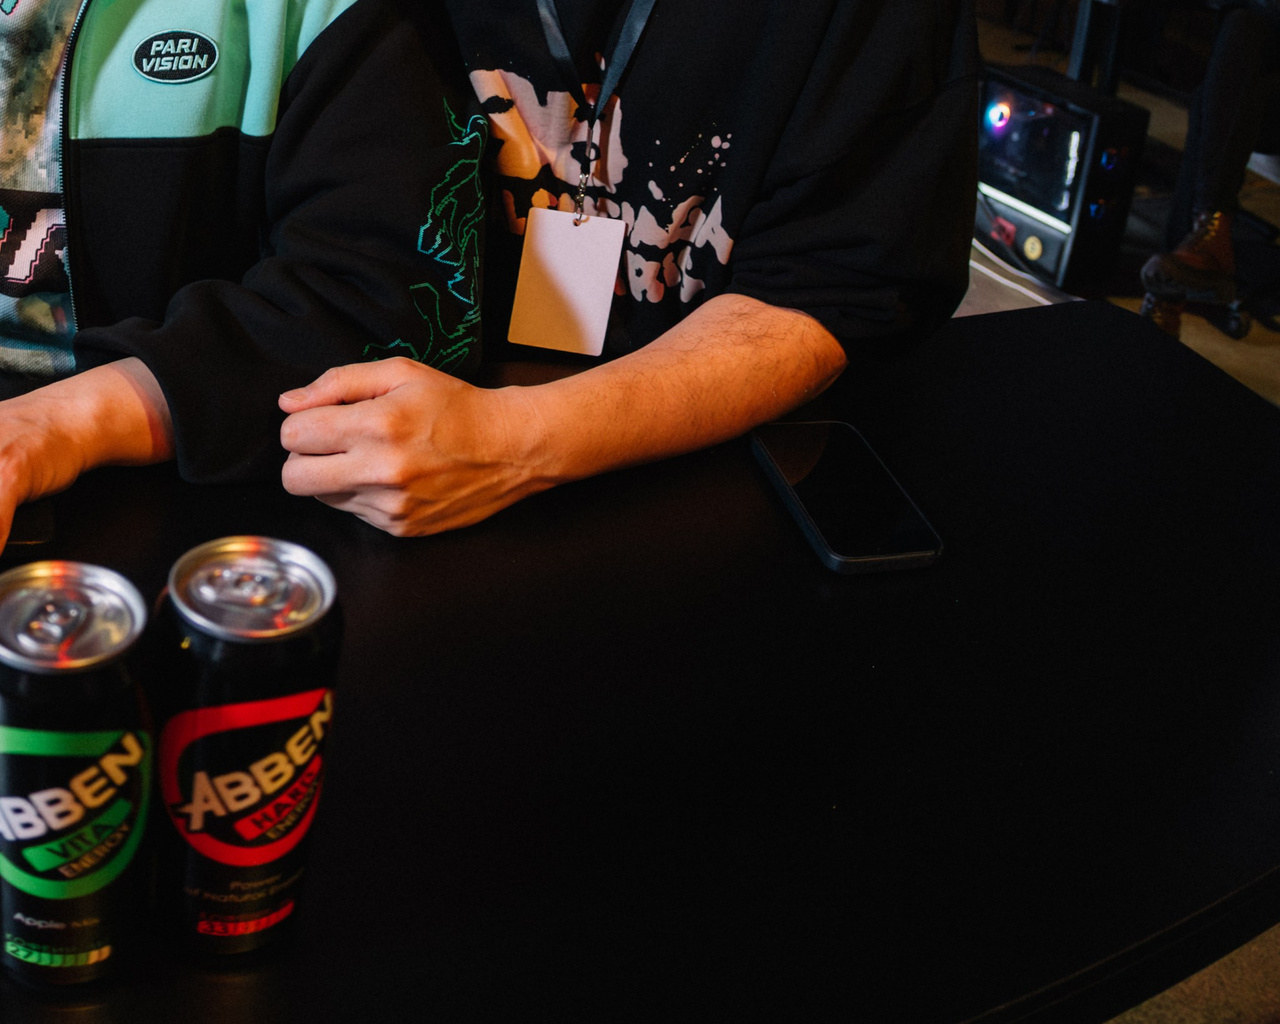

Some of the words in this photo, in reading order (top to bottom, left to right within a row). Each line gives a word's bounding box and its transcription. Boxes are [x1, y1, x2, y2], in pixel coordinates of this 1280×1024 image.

[150, 37, 199, 56] PARI
[142, 54, 209, 73] VISION
[177, 689, 333, 832] ABBEN
[45, 824, 117, 860] VITA
